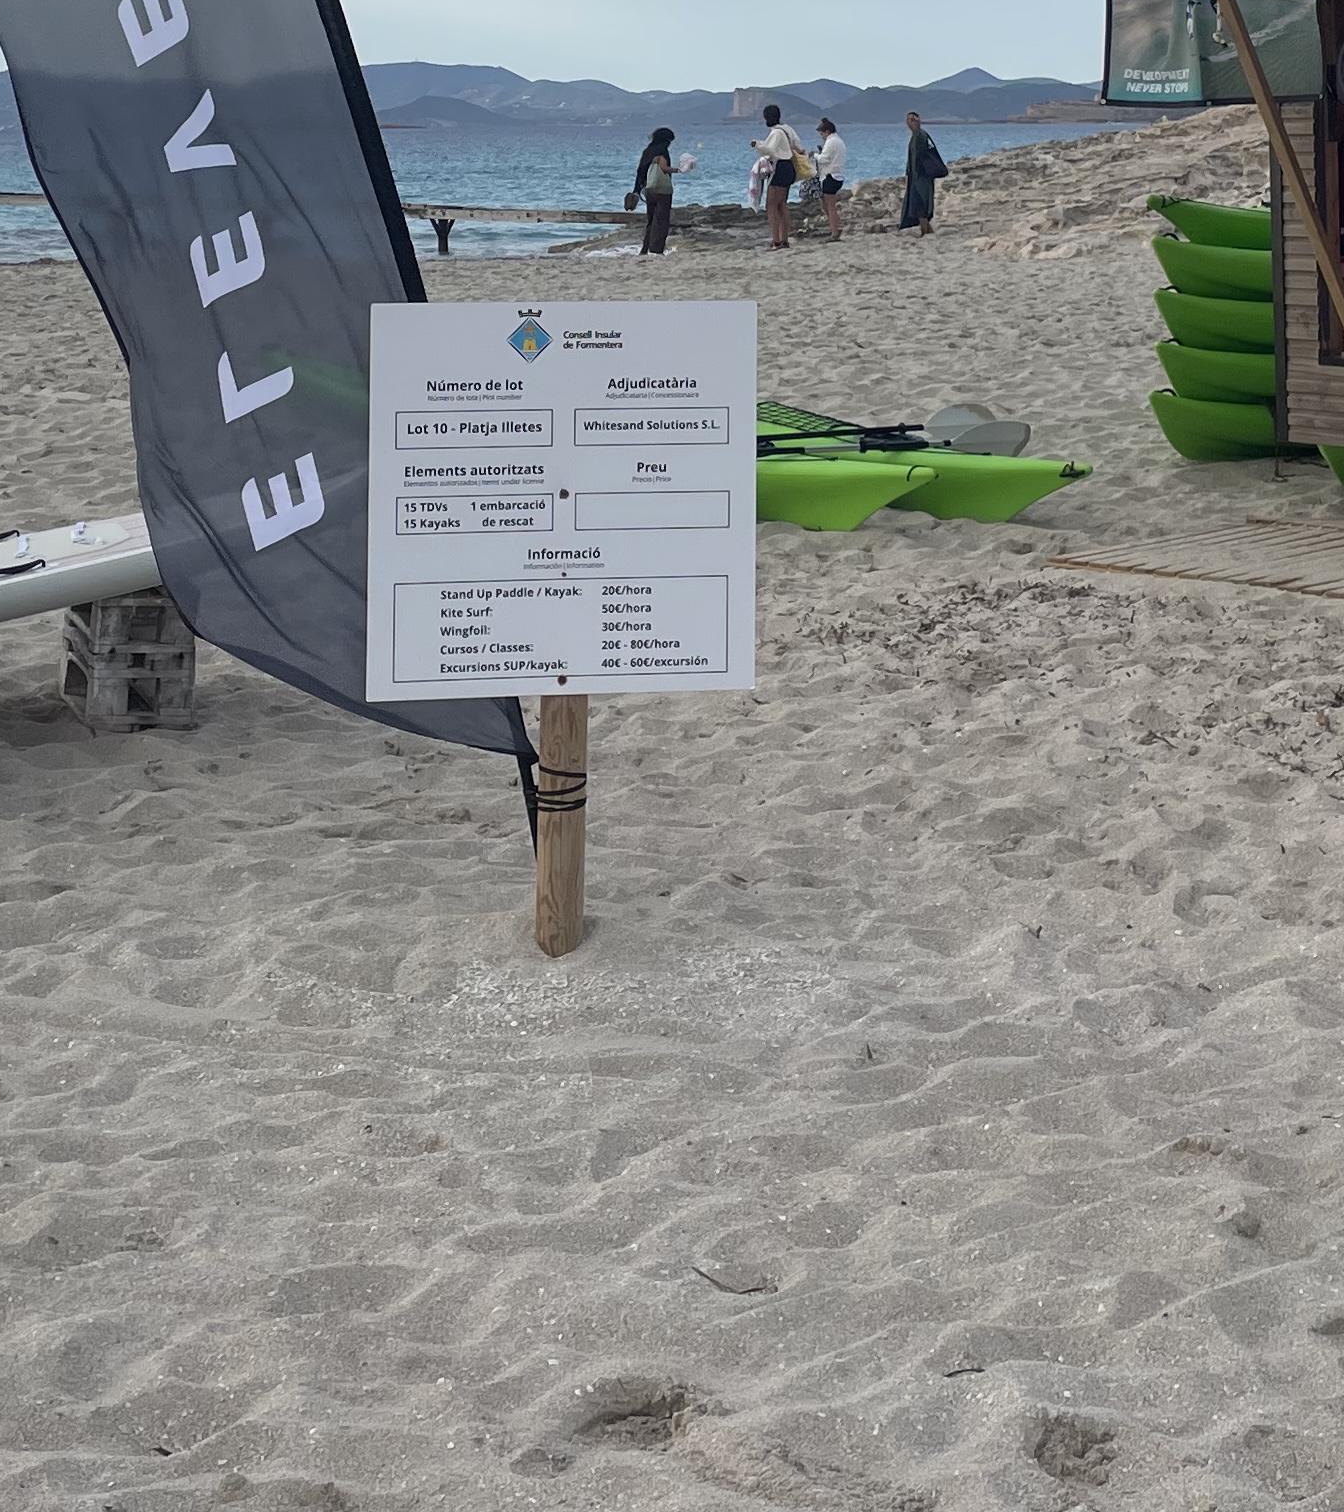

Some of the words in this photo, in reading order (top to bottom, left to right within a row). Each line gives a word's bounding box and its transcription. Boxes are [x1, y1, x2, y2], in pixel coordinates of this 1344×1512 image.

[1126, 81, 1162, 93] NEVER
[1164, 82, 1189, 94] STOPS
[563, 331, 592, 339] Consell
[595, 330, 622, 339] Insular
[563, 341, 573, 349] de
[576, 341, 623, 349] Formentera
[426, 379, 482, 392] Número
[485, 379, 502, 391] de
[505, 379, 524, 391] lot
[607, 376, 697, 392] Adjudicatària
[407, 423, 429, 435] Lot
[432, 423, 448, 435] 10
[459, 421, 498, 437] Platja
[501, 420, 543, 434] Illetes
[583, 420, 644, 431] Whitesand
[647, 419, 699, 430] Solutions
[701, 420, 721, 430] S.L.
[404, 465, 467, 478] Elements
[470, 464, 545, 476] autoritzats
[636, 461, 667, 473] Preu
[404, 502, 417, 513] 15
[420, 502, 448, 512] TDVs
[470, 501, 476, 512] 1
[479, 499, 546, 511] embarcació
[404, 519, 417, 529] 15
[420, 518, 461, 531] Kayaks
[482, 517, 496, 528] de
[498, 517, 534, 527] rescat
[527, 546, 601, 560] Informació
[440, 588, 473, 600] Stand
[477, 589, 493, 601] Up
[495, 587, 534, 598] Paddle
[544, 586, 583, 600] Kayak:
[601, 585, 652, 596] 20€/hora
[440, 607, 464, 619] Kite
[466, 606, 493, 618] Surf:
[601, 603, 652, 614] 50€/hora
[440, 625, 491, 639] Wingfoil:
[601, 621, 652, 632] 30€/hora
[440, 644, 479, 655] Cursos
[489, 643, 534, 654] Classes:
[601, 639, 622, 650] 20€
[630, 638, 681, 650] 80€/hora
[440, 662, 501, 674] Excursions
[503, 659, 569, 673] SUP/kayak:
[601, 658, 622, 668] 40€
[630, 655, 709, 668] 60€/excursión
